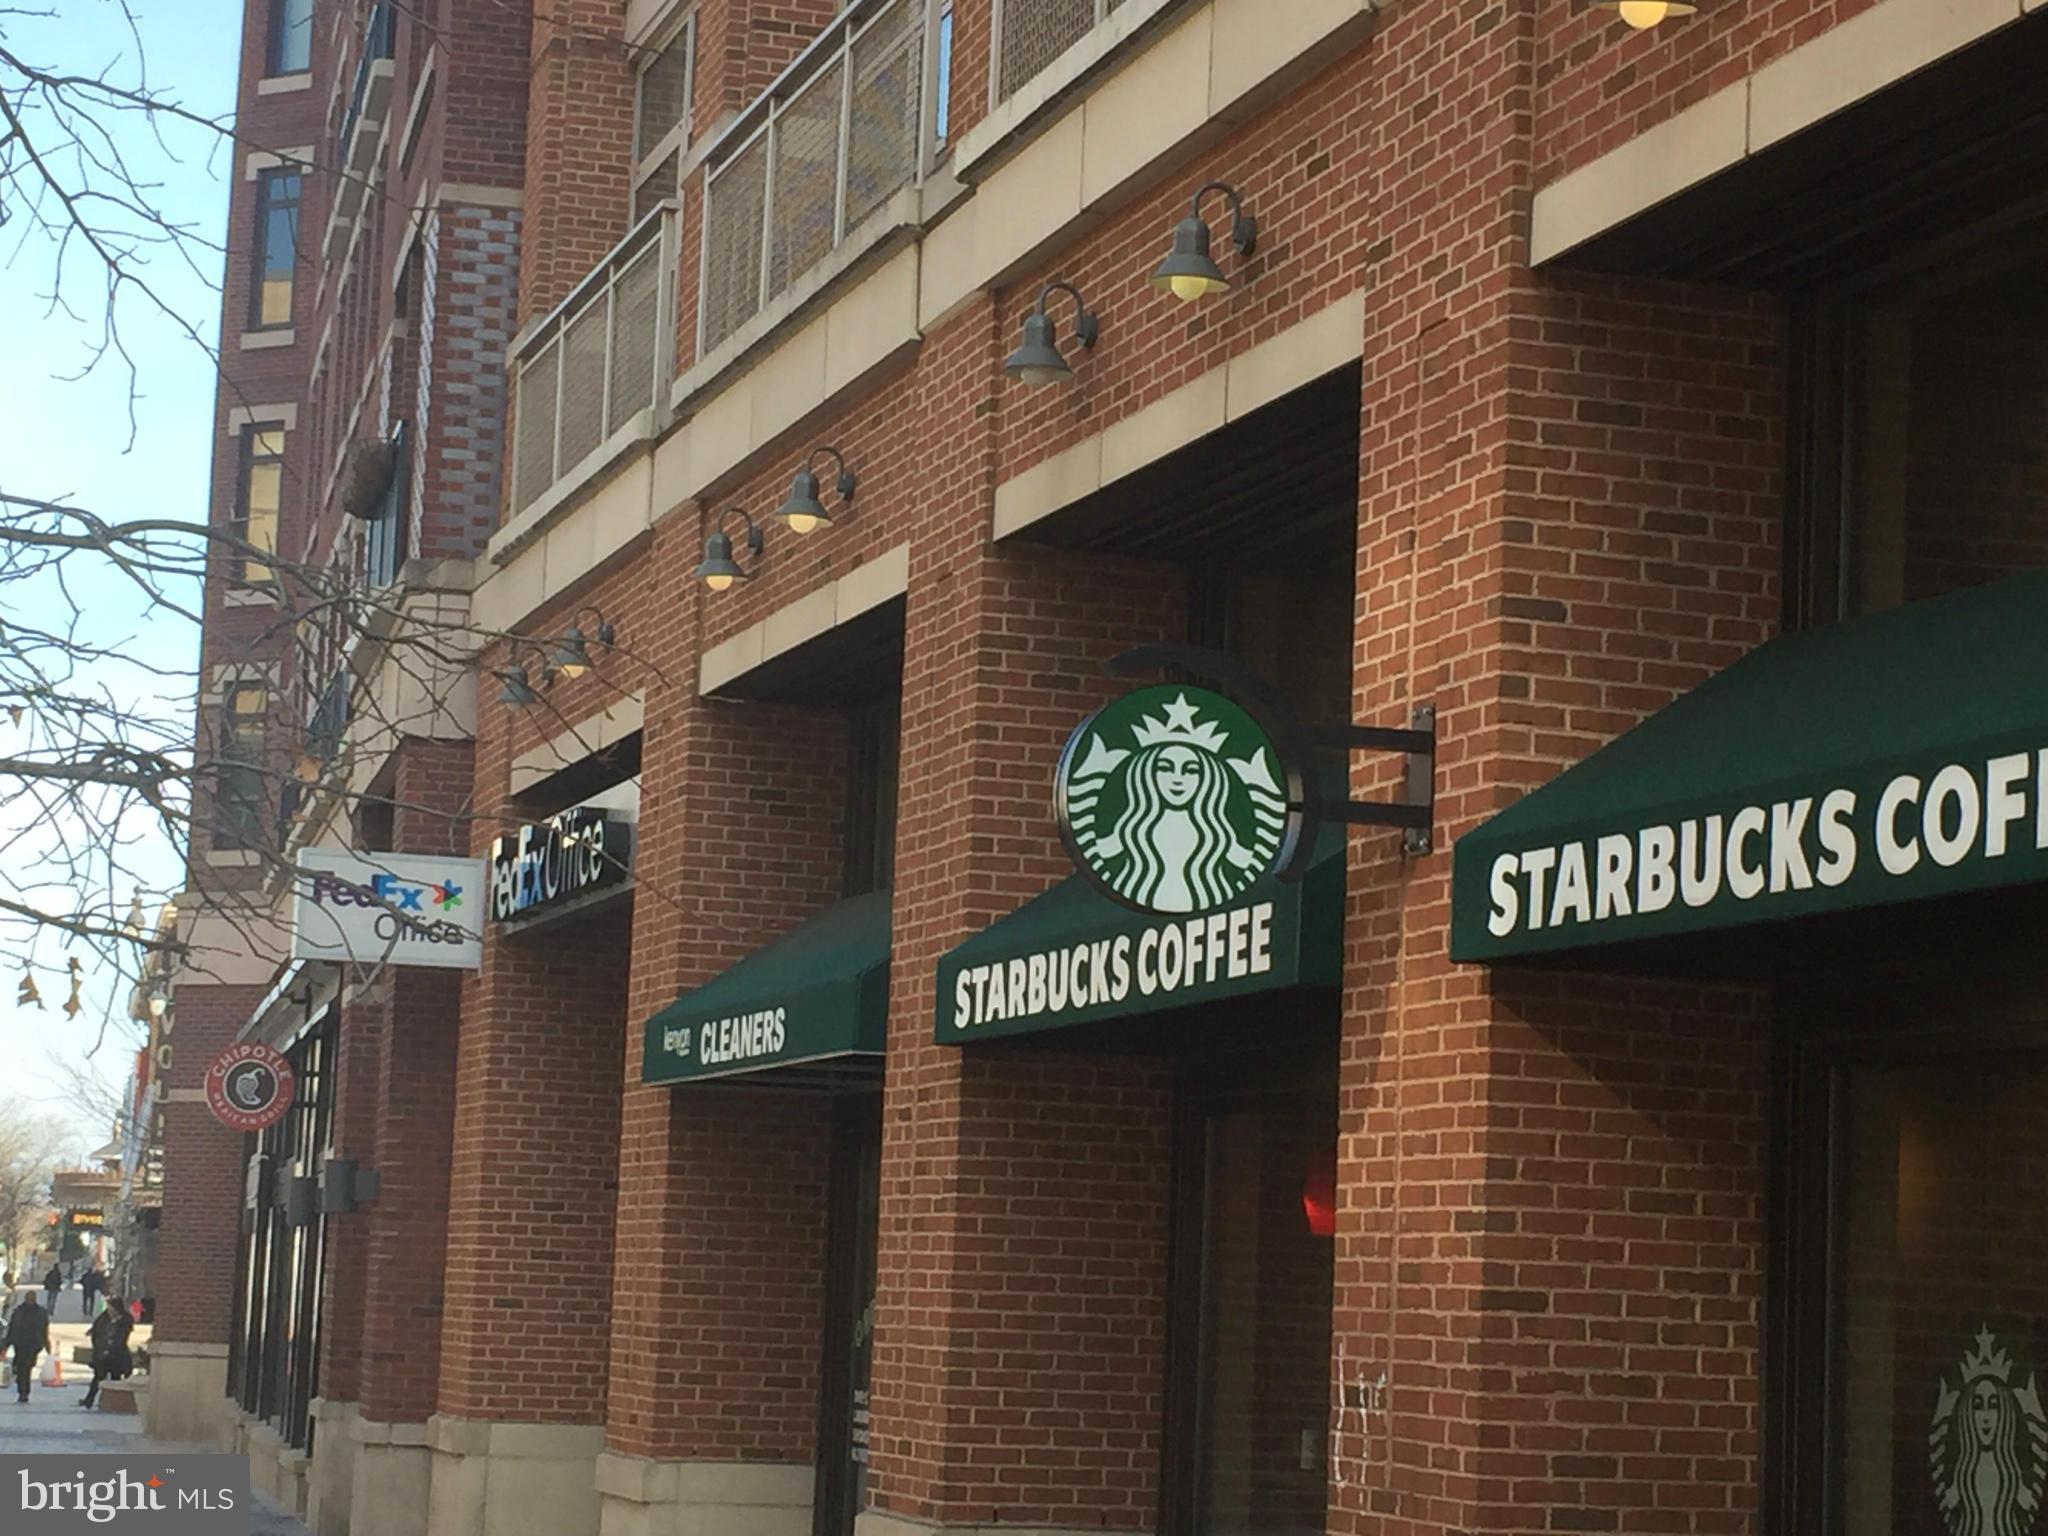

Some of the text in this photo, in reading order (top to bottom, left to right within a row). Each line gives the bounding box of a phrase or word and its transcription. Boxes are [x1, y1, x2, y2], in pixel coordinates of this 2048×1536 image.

[490, 809, 605, 920] FedEx Office
[1486, 788, 1857, 938] STARBUCKS
[953, 902, 1274, 1030] STARBUCKS COFFEE
[212, 1045, 293, 1081] CHIPOTLE
[699, 1006, 787, 1066] CLEANERS
